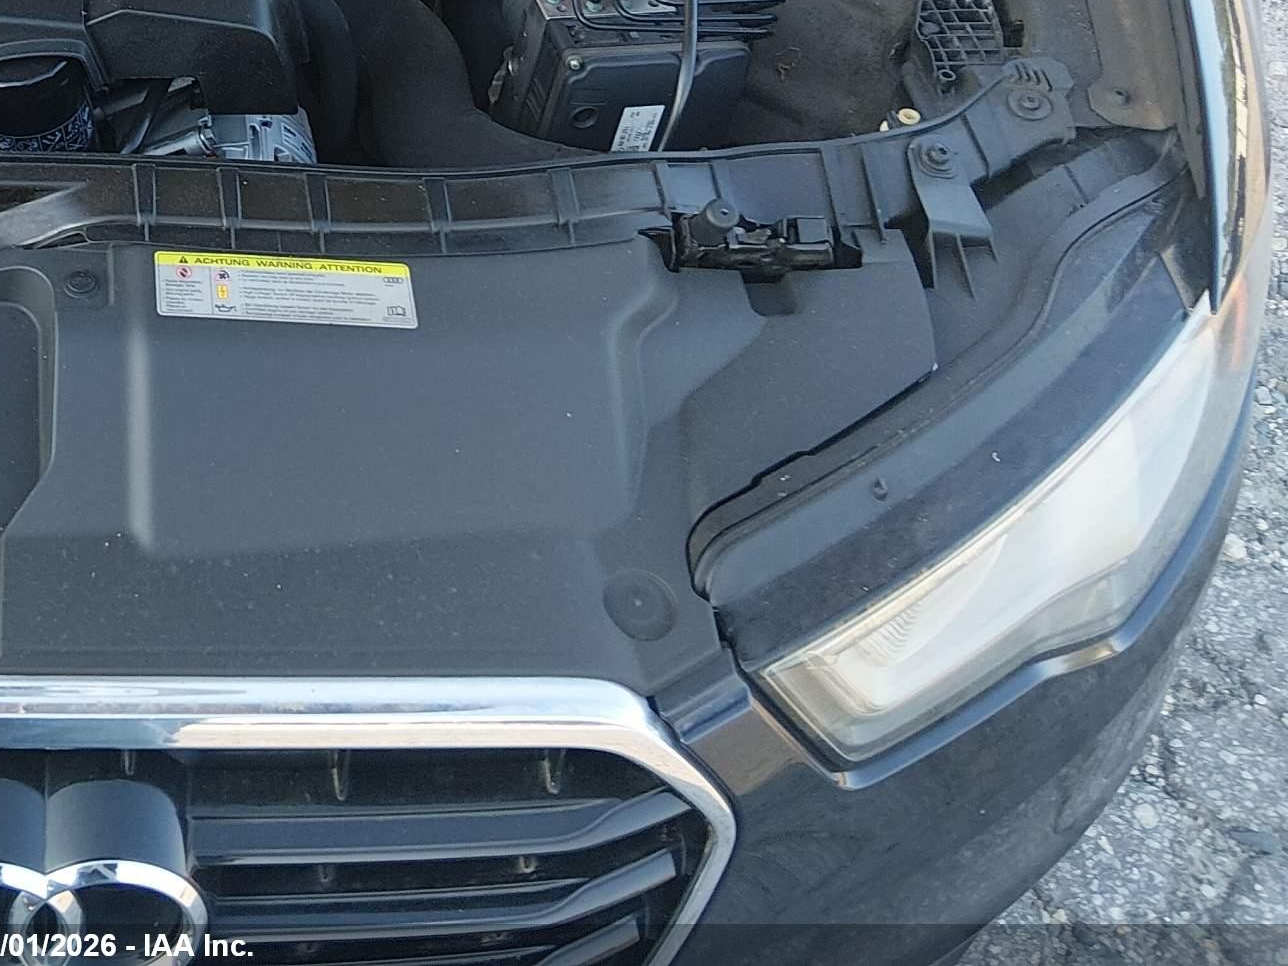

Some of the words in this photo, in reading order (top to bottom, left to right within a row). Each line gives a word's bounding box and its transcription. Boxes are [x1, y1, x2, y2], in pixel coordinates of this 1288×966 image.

[194, 256, 251, 267] ACHTUNG
[255, 259, 313, 270] WARNING
[318, 263, 383, 274] ATTENTION
